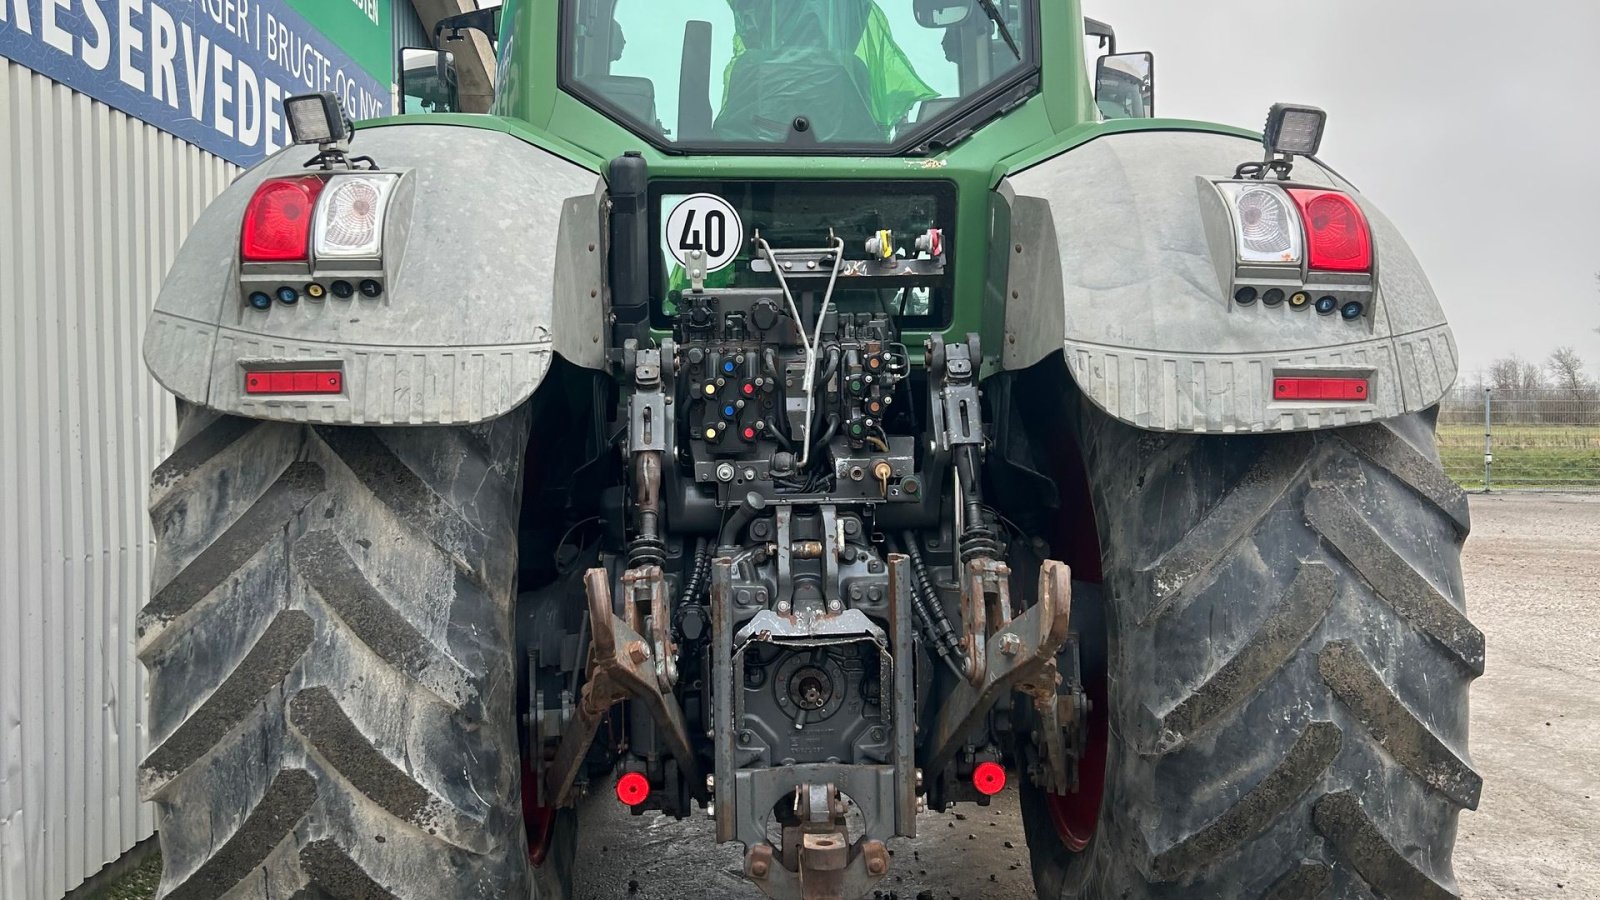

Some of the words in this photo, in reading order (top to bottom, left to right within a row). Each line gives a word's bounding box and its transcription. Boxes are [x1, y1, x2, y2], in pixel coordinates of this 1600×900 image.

[188, 0, 250, 44] GER
[256, 4, 260, 51] I
[267, 13, 331, 92] BRUGTE
[336, 69, 356, 119] OG
[679, 209, 726, 258] 40
